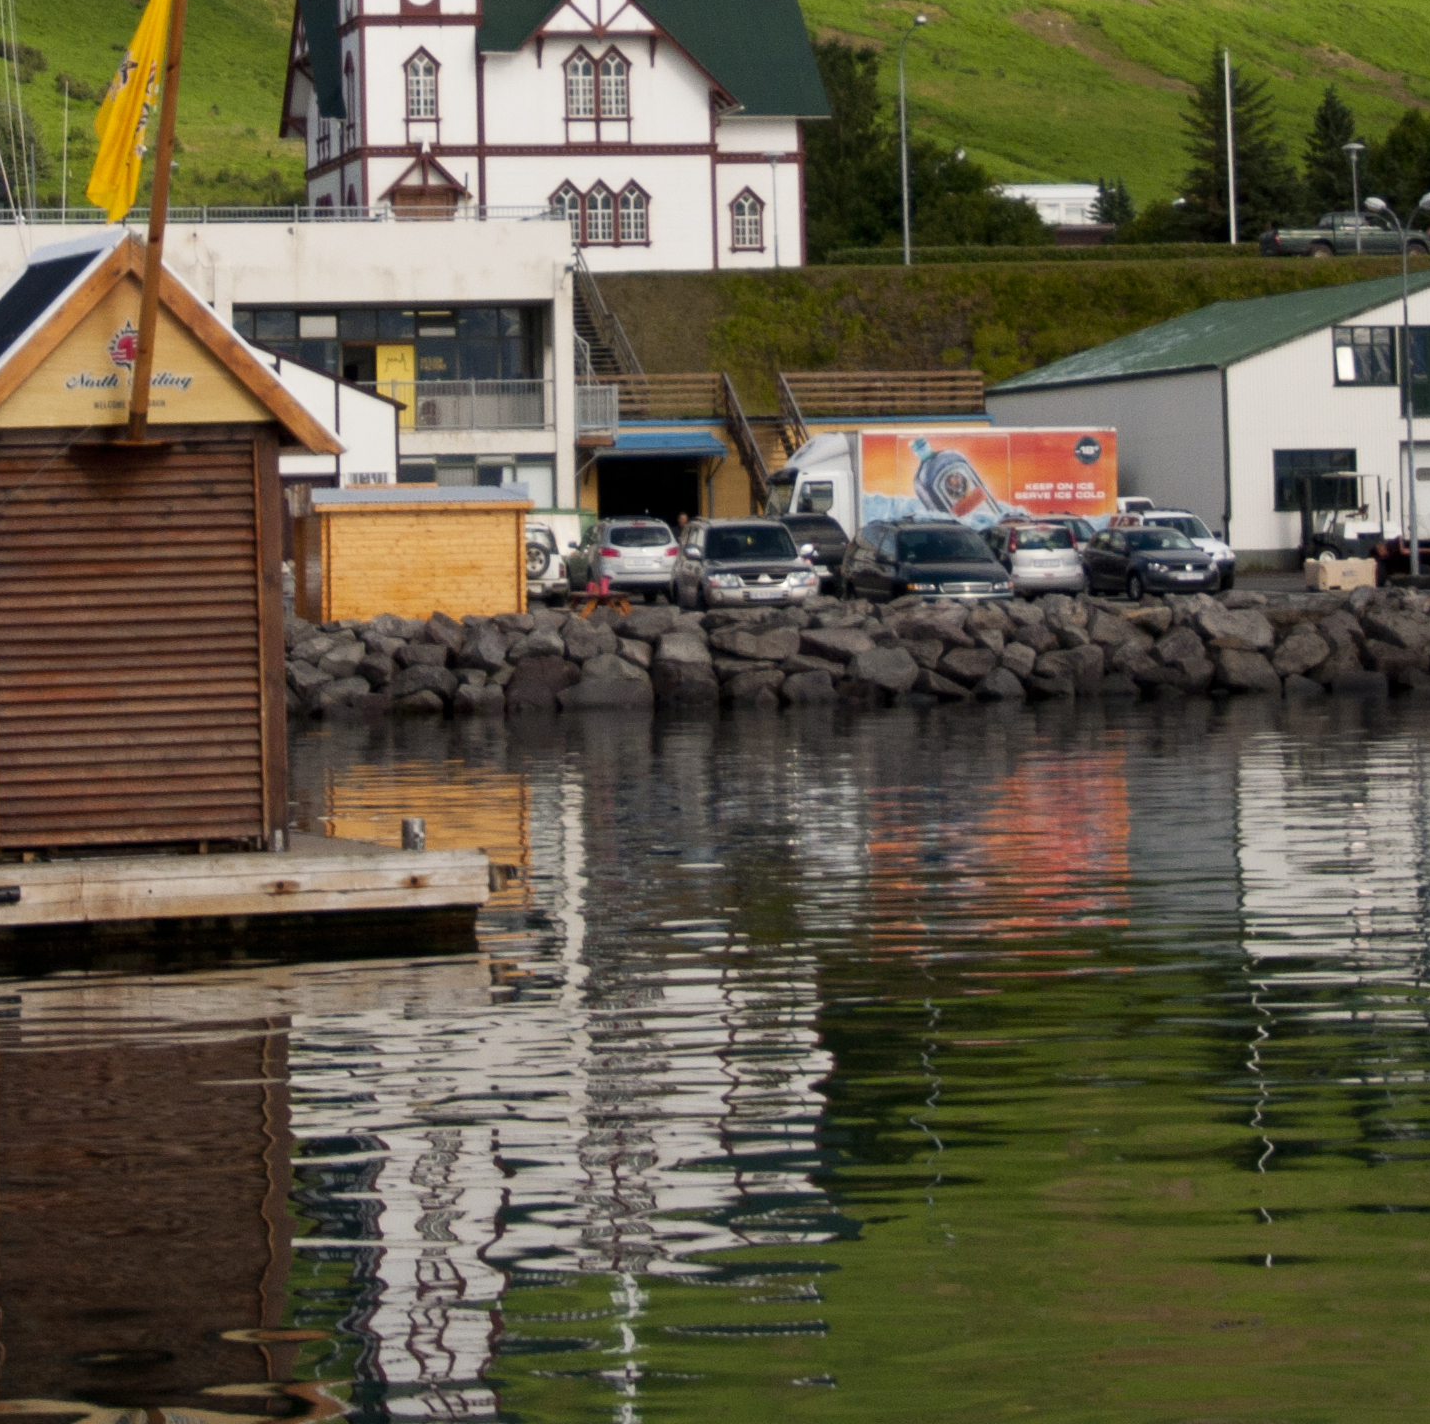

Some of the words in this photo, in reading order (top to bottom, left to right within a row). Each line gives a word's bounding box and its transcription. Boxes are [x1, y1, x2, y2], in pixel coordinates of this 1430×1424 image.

[66, 372, 119, 389] North
[128, 371, 192, 391] iling
[1025, 482, 1054, 490] KEEP
[1057, 482, 1073, 490] ON
[1077, 482, 1094, 490] ICE
[1014, 491, 1050, 499] SERVE
[1054, 491, 1072, 499] ICE
[1075, 491, 1105, 499] COLD
